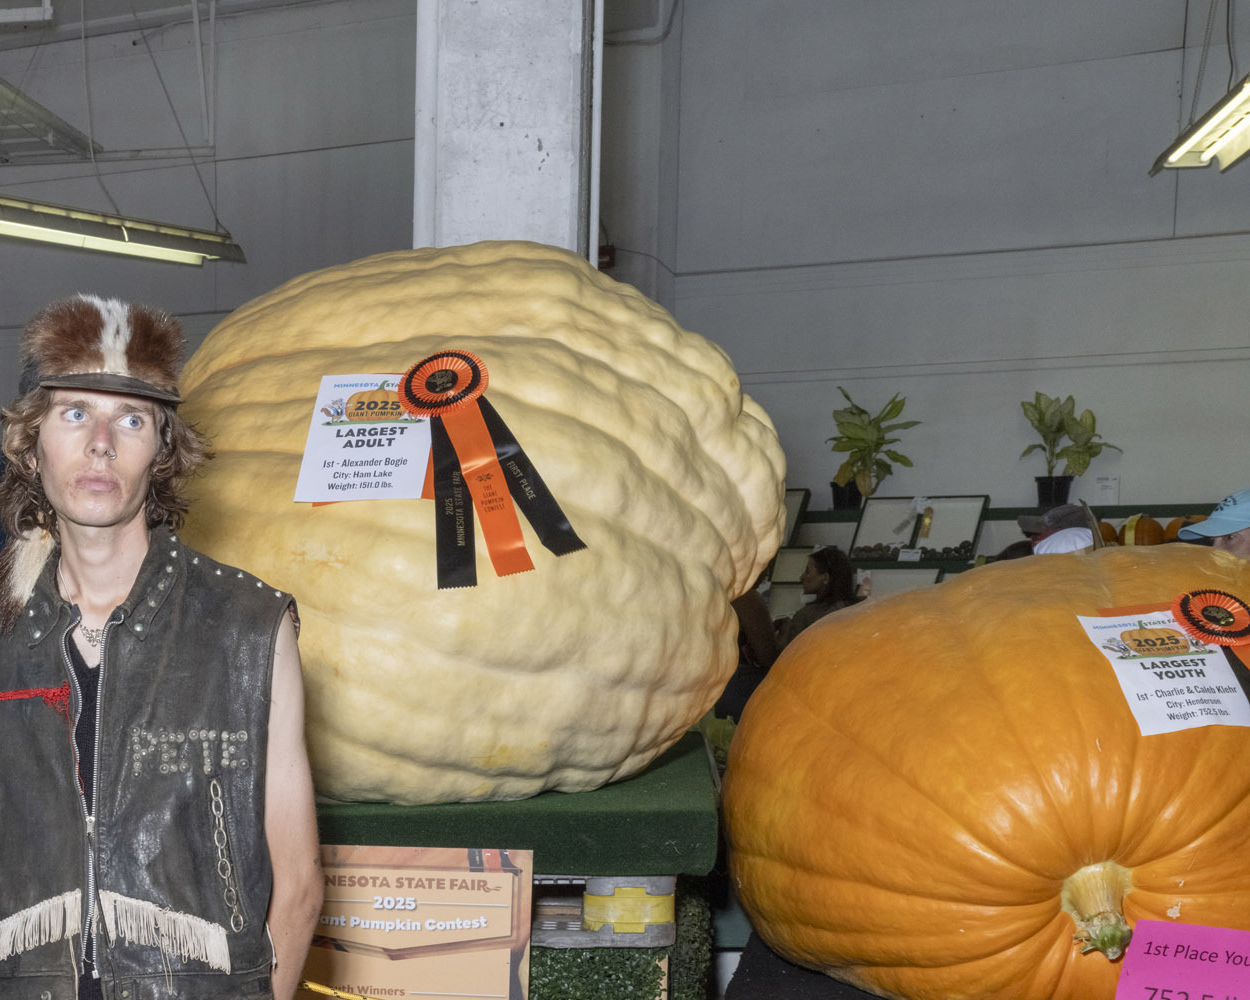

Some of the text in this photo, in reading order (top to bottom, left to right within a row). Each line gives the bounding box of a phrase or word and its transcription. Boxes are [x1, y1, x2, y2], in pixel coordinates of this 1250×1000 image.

[355, 401, 401, 411] 2025
[336, 426, 408, 438] LARGEST
[342, 438, 396, 449] ADULT
[341, 458, 383, 468] Alexander
[384, 457, 408, 468] Bogie
[333, 470, 393, 480] City: Ham Lake
[506, 461, 537, 500] FIRST PLACE
[327, 482, 358, 491] Weight:
[445, 498, 454, 515] 2025
[453, 486, 466, 547] MINNESOTA STATE
[1143, 619, 1166, 627] STATE
[1133, 635, 1181, 647] 2025
[1140, 658, 1207, 670] LARGEST
[1153, 669, 1207, 680] YOUTH
[1155, 688, 1186, 699] Charlie
[1186, 686, 1195, 695] &
[1195, 685, 1216, 695] Caleb
[1217, 685, 1238, 694] Klehr
[1166, 698, 1222, 710] City: Henderson
[1167, 710, 1199, 721] Weight:
[324, 875, 492, 892] NESOTA STATE FAIR
[373, 896, 417, 910] 2025
[319, 915, 488, 932] ant Pumpkin Contest
[1143, 941, 1250, 967] 1st Place You
[357, 985, 406, 997] Winners
